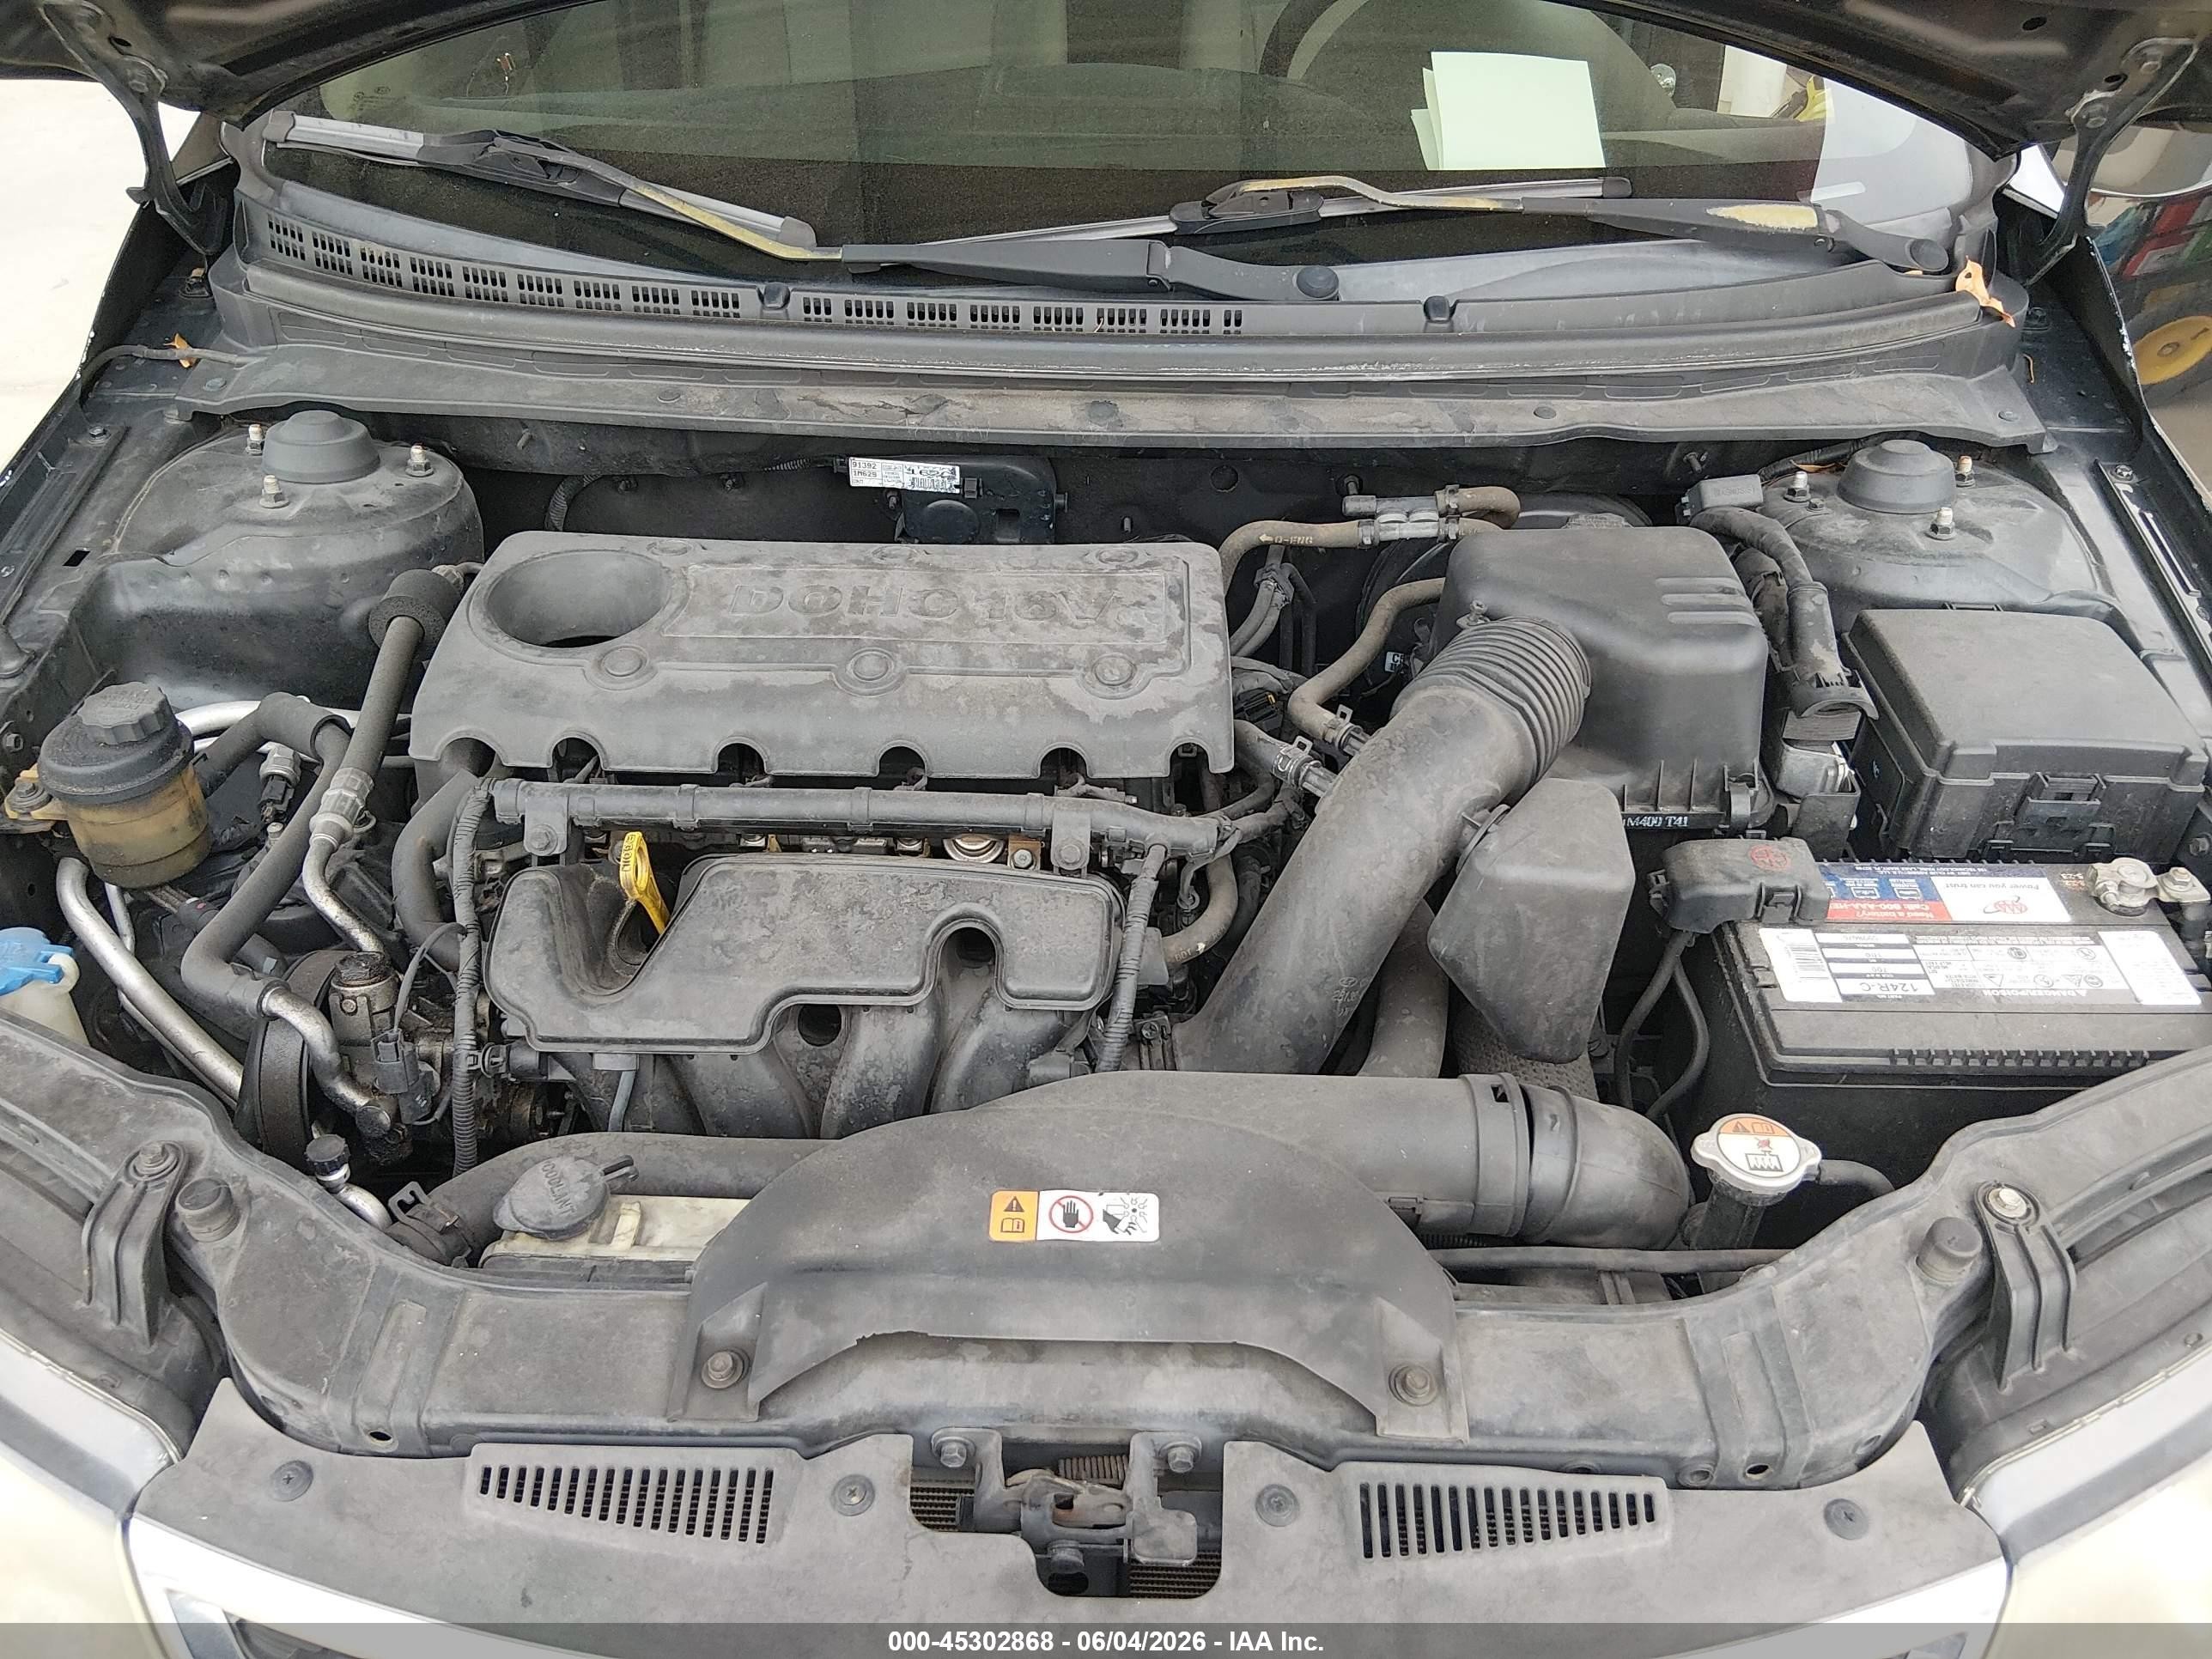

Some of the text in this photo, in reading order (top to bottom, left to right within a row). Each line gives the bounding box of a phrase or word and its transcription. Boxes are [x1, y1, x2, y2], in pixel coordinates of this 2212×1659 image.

[852, 461, 877, 470] 91392
[728, 583, 1121, 623] DOHC 16V
[1860, 982, 1919, 992] 124R-C
